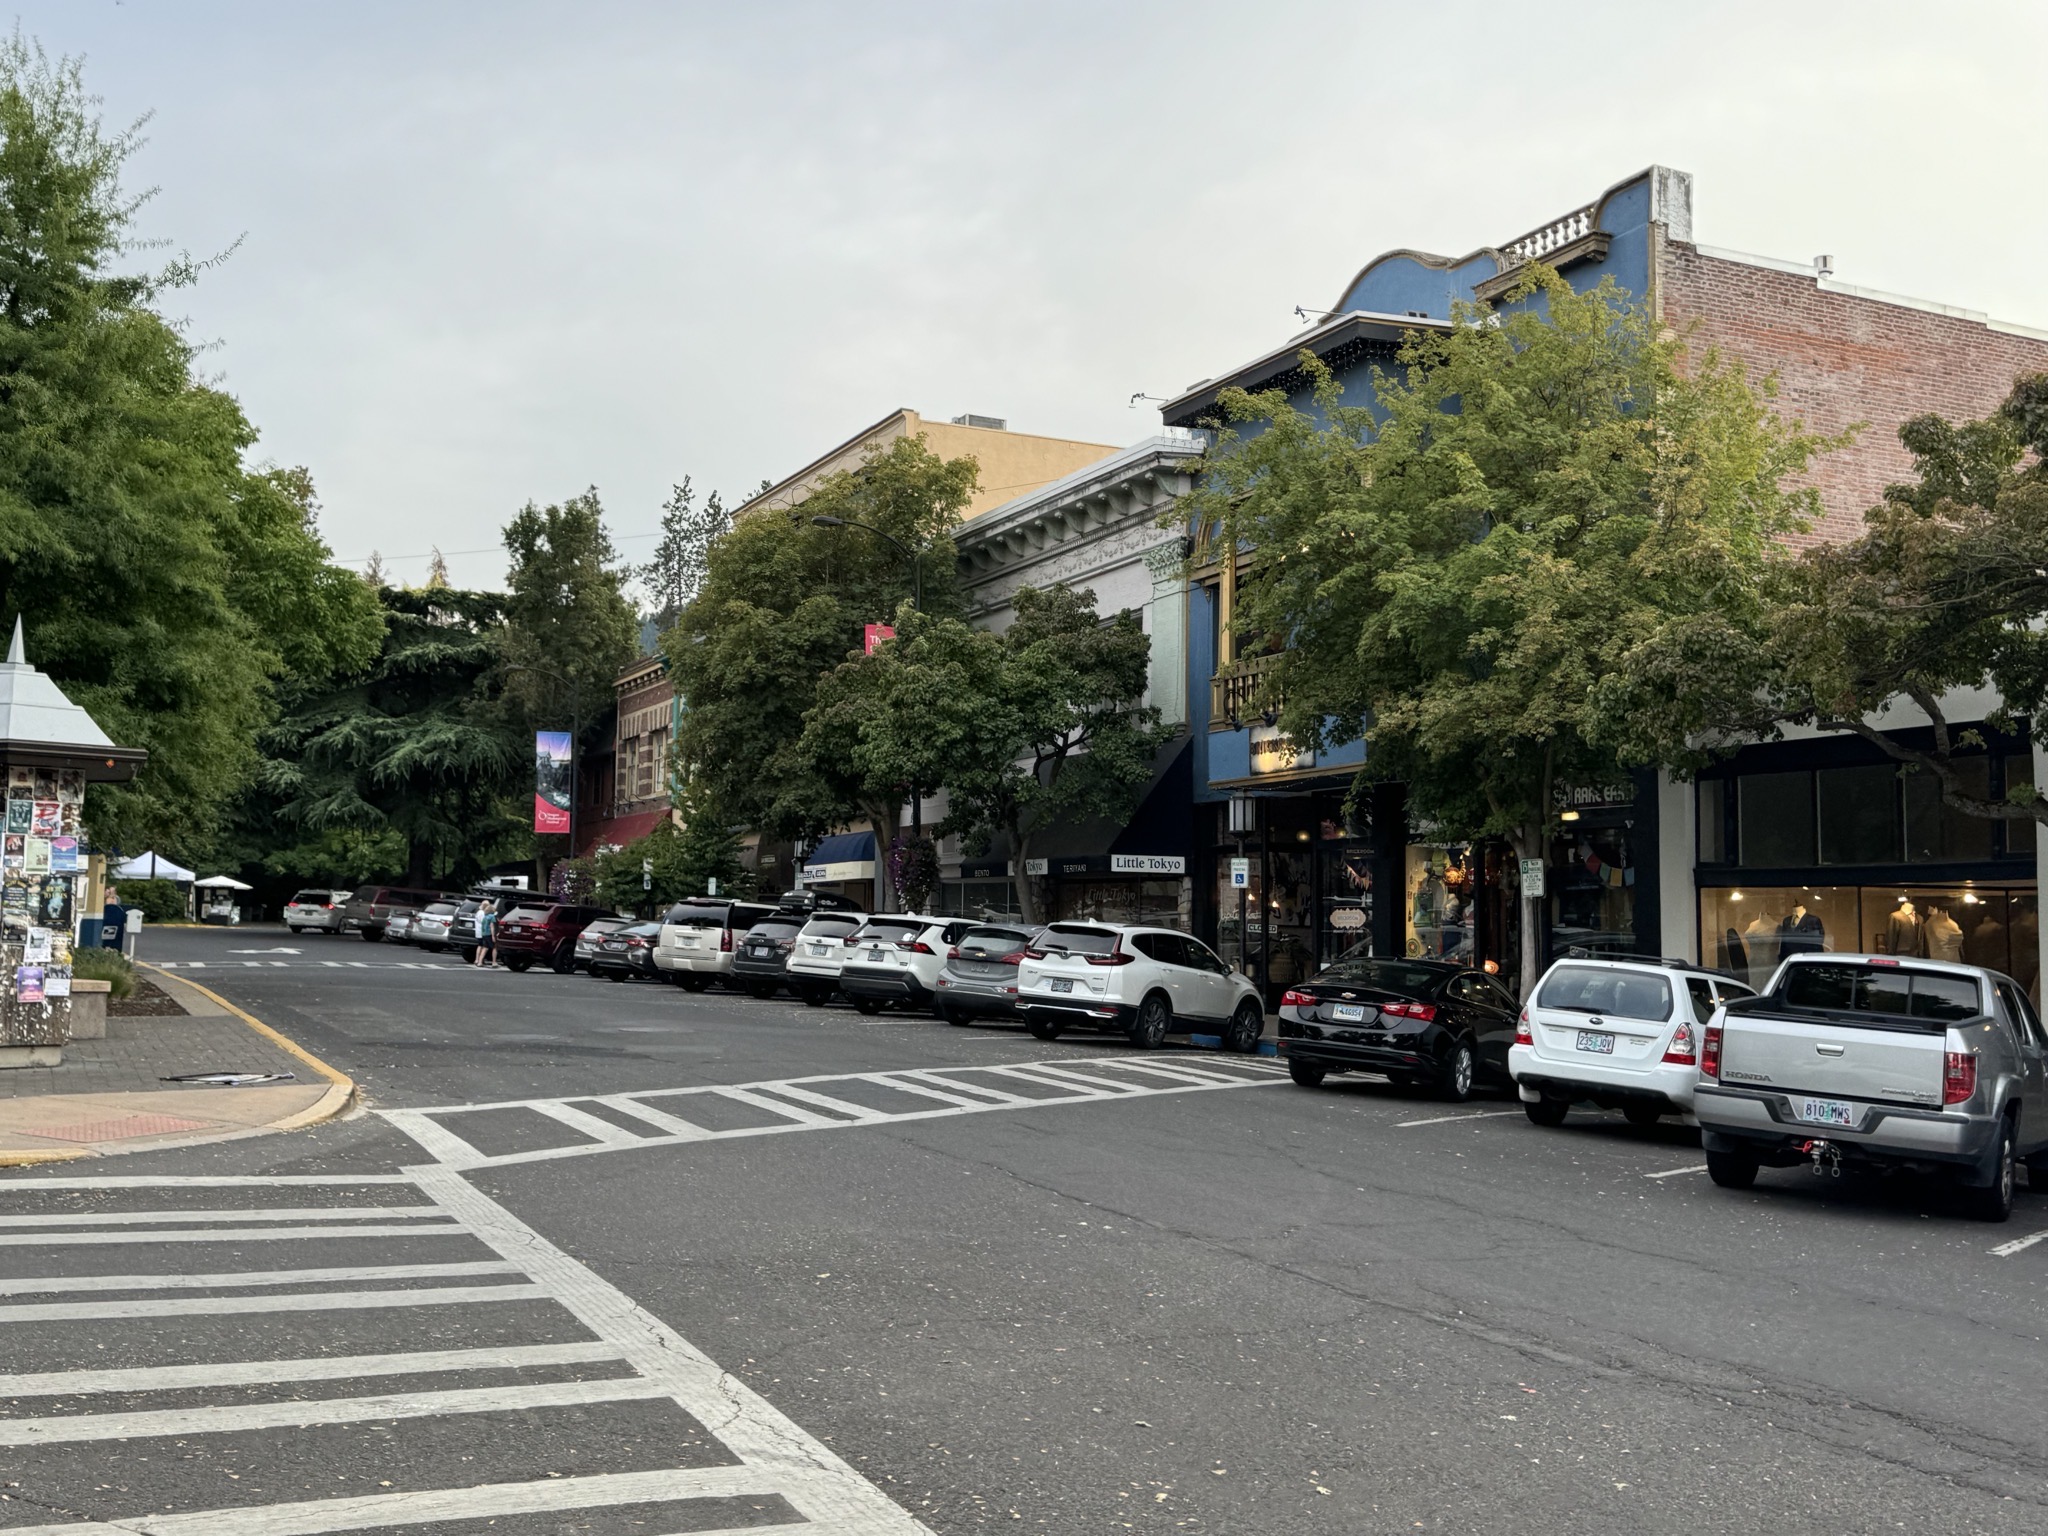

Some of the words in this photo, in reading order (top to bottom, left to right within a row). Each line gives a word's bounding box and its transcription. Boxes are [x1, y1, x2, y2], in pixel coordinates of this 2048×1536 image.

[1027, 861, 1043, 873] Tokyo
[1063, 864, 1087, 873] TERIYAKI
[1116, 857, 1145, 869] Little
[1148, 858, 1181, 872] Tokyo
[974, 869, 990, 877] BENTO
[1579, 1036, 1593, 1046] 235
[1725, 1071, 1773, 1082] HONDA
[1806, 1103, 1825, 1117] 810
[1831, 1106, 1850, 1120] MWS
